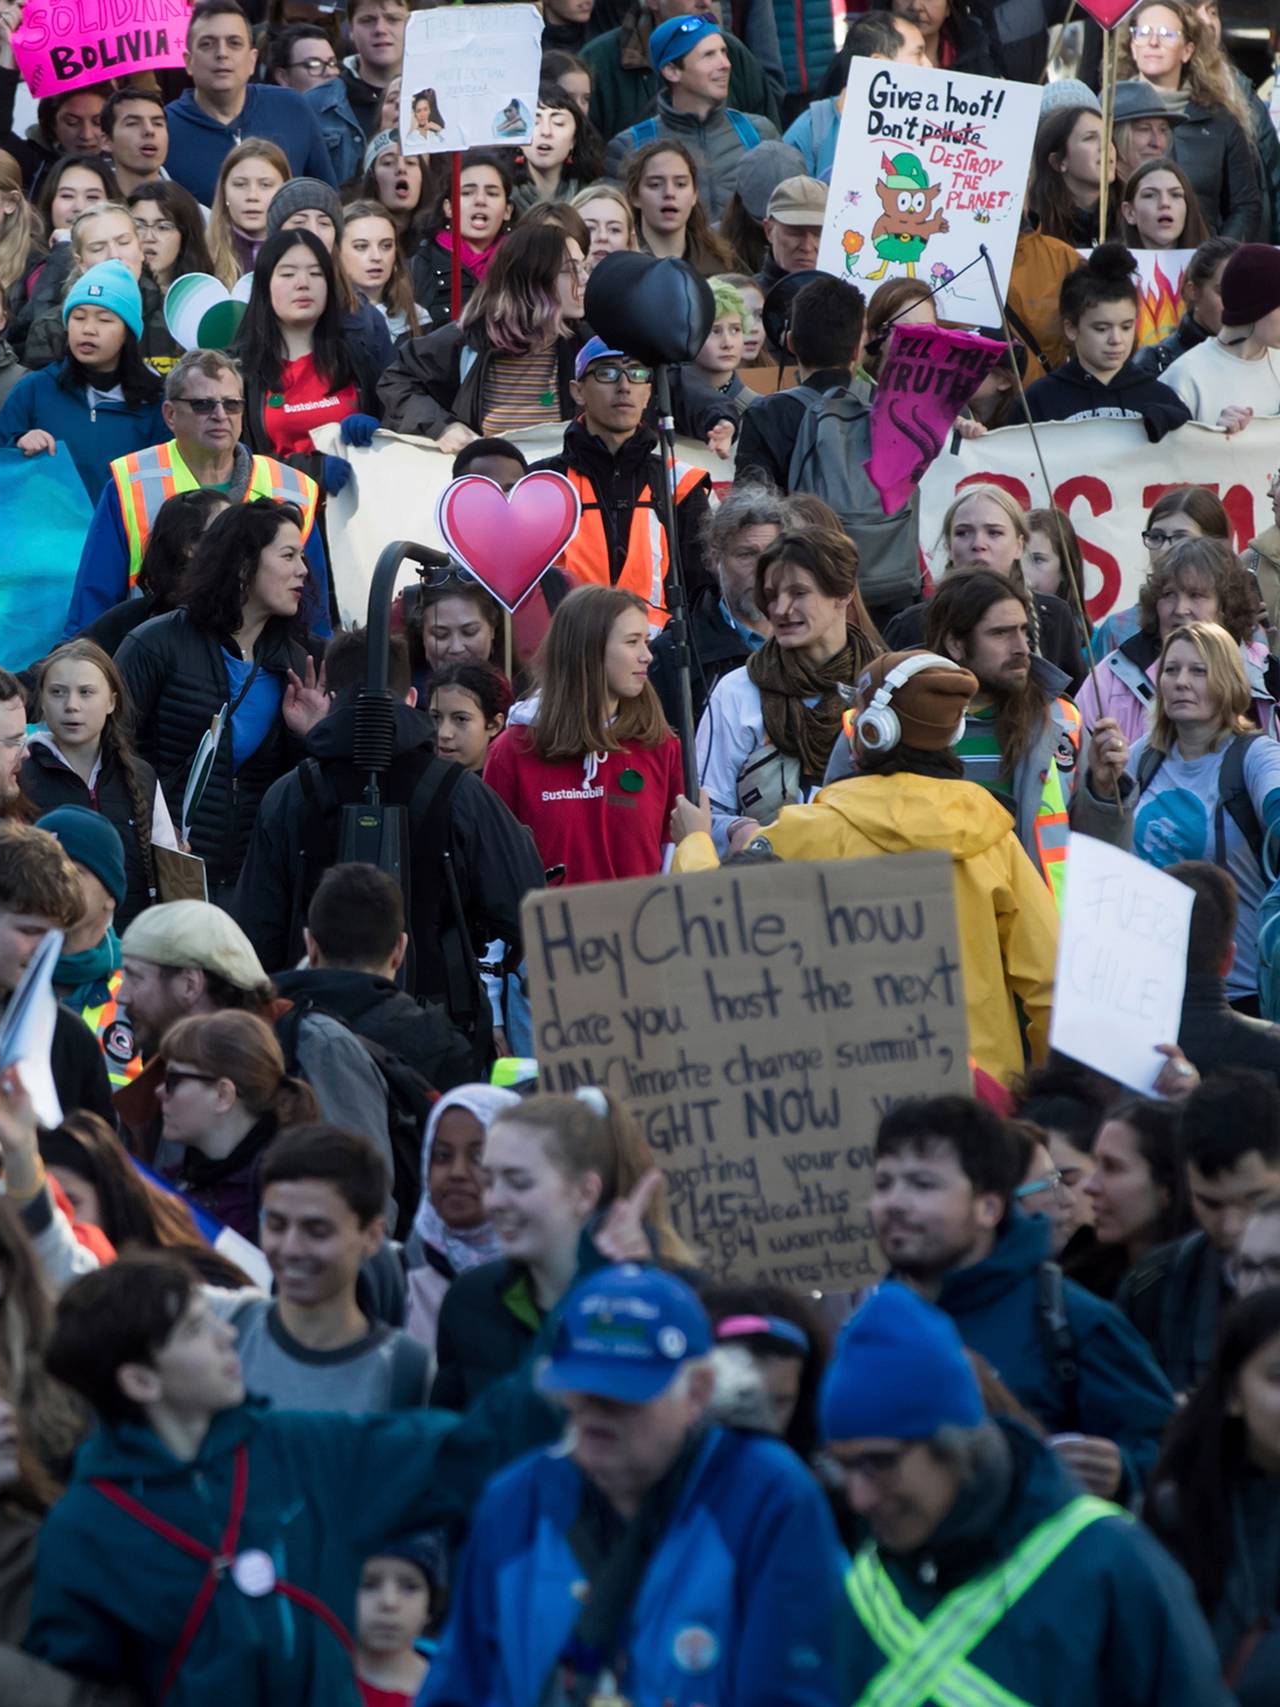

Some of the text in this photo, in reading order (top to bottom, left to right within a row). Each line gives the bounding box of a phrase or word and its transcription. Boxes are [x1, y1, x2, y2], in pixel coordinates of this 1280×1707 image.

[49, 28, 170, 81] BOLIVIA
[868, 70, 1006, 119] Give a hoot!
[867, 109, 982, 147] Don't pollute
[929, 145, 1003, 177] DESTROY
[951, 172, 983, 191] THE
[945, 191, 1011, 210] PLANET
[878, 360, 979, 404] TRUTH
[535, 870, 926, 1001] Hey Chile, how
[539, 946, 960, 1061] dare you host the next
[722, 1042, 824, 1093] change
[834, 1012, 955, 1076] summit,
[632, 1098, 722, 1153] GHT
[743, 1087, 842, 1140] NOW
[782, 1147, 843, 1192] your
[767, 1209, 877, 1256] wounded
